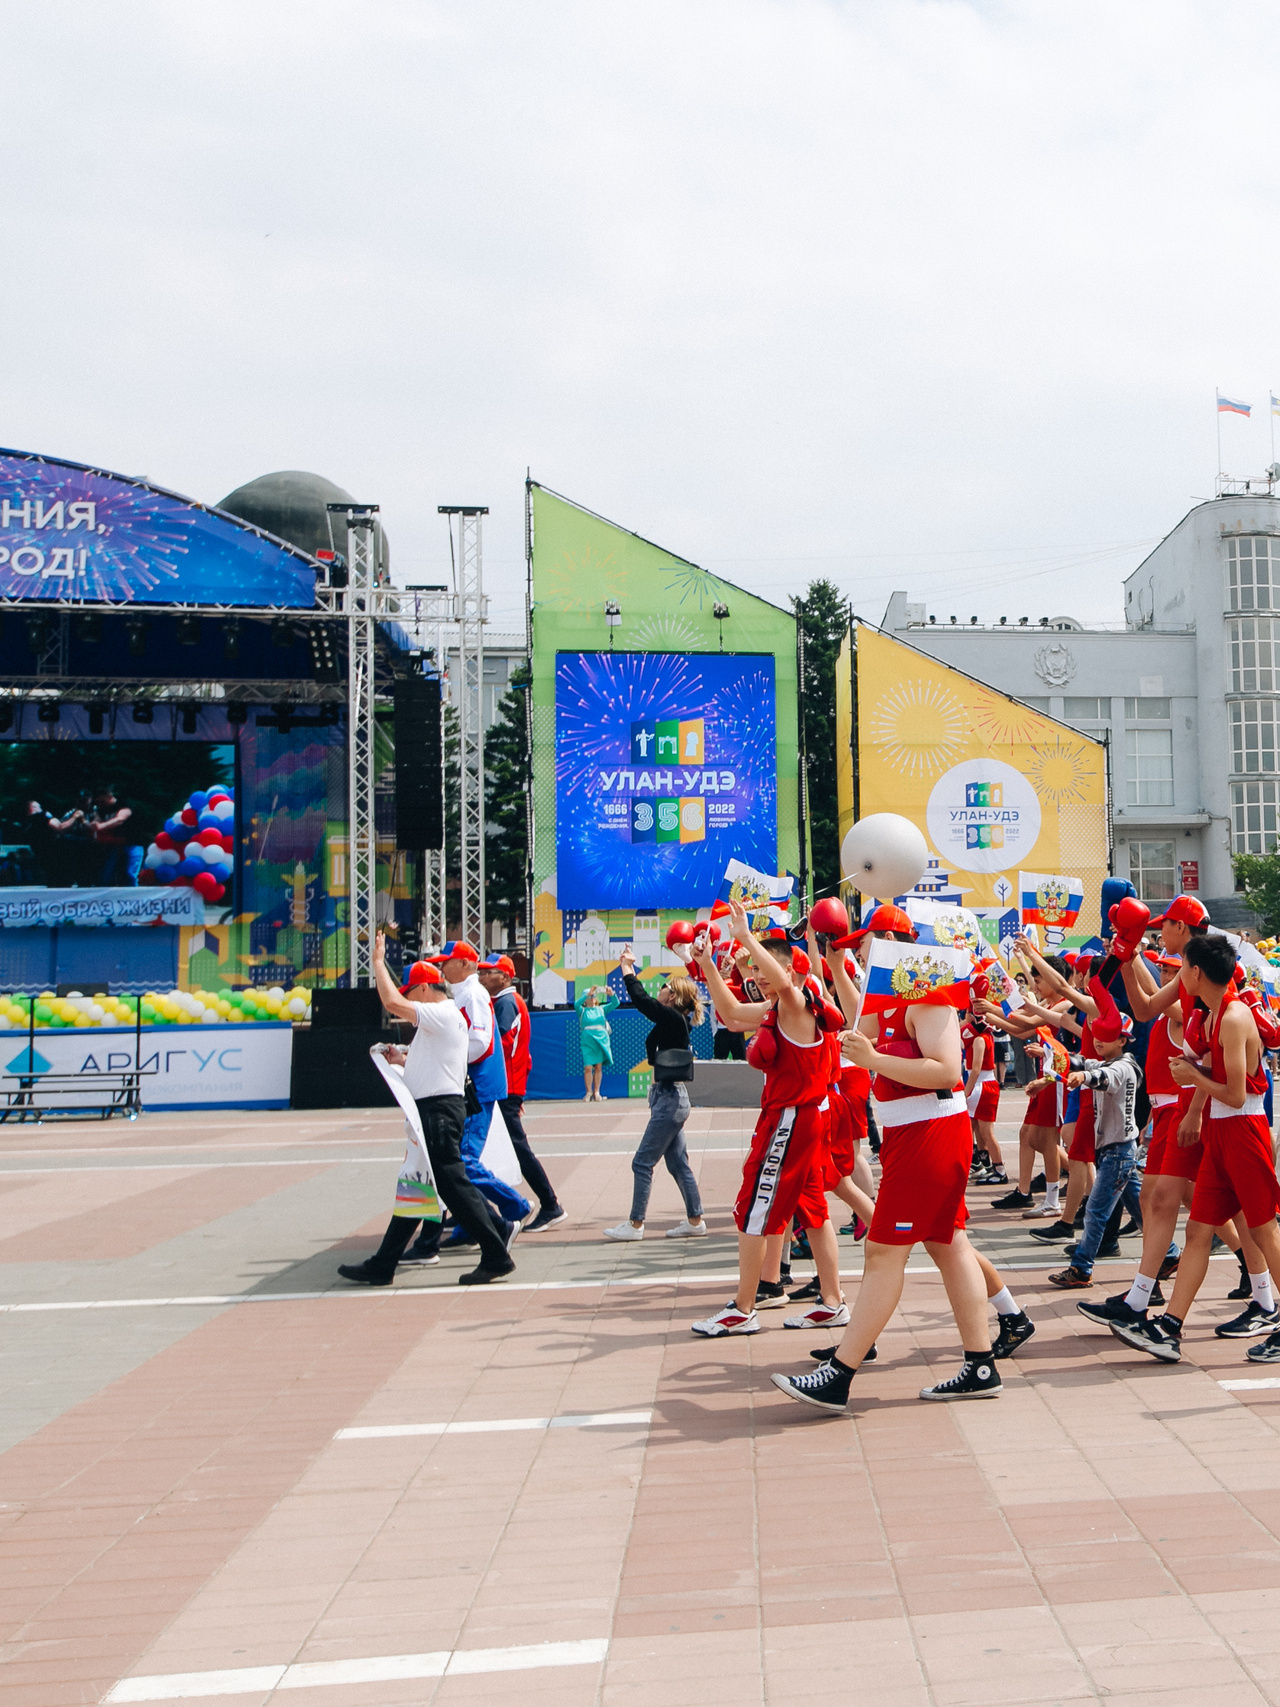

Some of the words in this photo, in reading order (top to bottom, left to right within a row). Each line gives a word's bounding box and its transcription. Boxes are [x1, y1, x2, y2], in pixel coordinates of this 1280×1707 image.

[2, 499, 106, 534] НИЯ,
[600, 771, 735, 794] УЛАН-УДЭ
[603, 803, 628, 815] 1666
[634, 803, 704, 831] 356
[707, 803, 736, 814] 2022
[950, 811, 1019, 822] УЛАН-УДЭ
[46, 901, 115, 918] ОБРАЗ
[118, 897, 192, 916] ЖИЗНИ
[80, 1048, 243, 1073] АРИГУС
[757, 1127, 789, 1205] JORDAN
